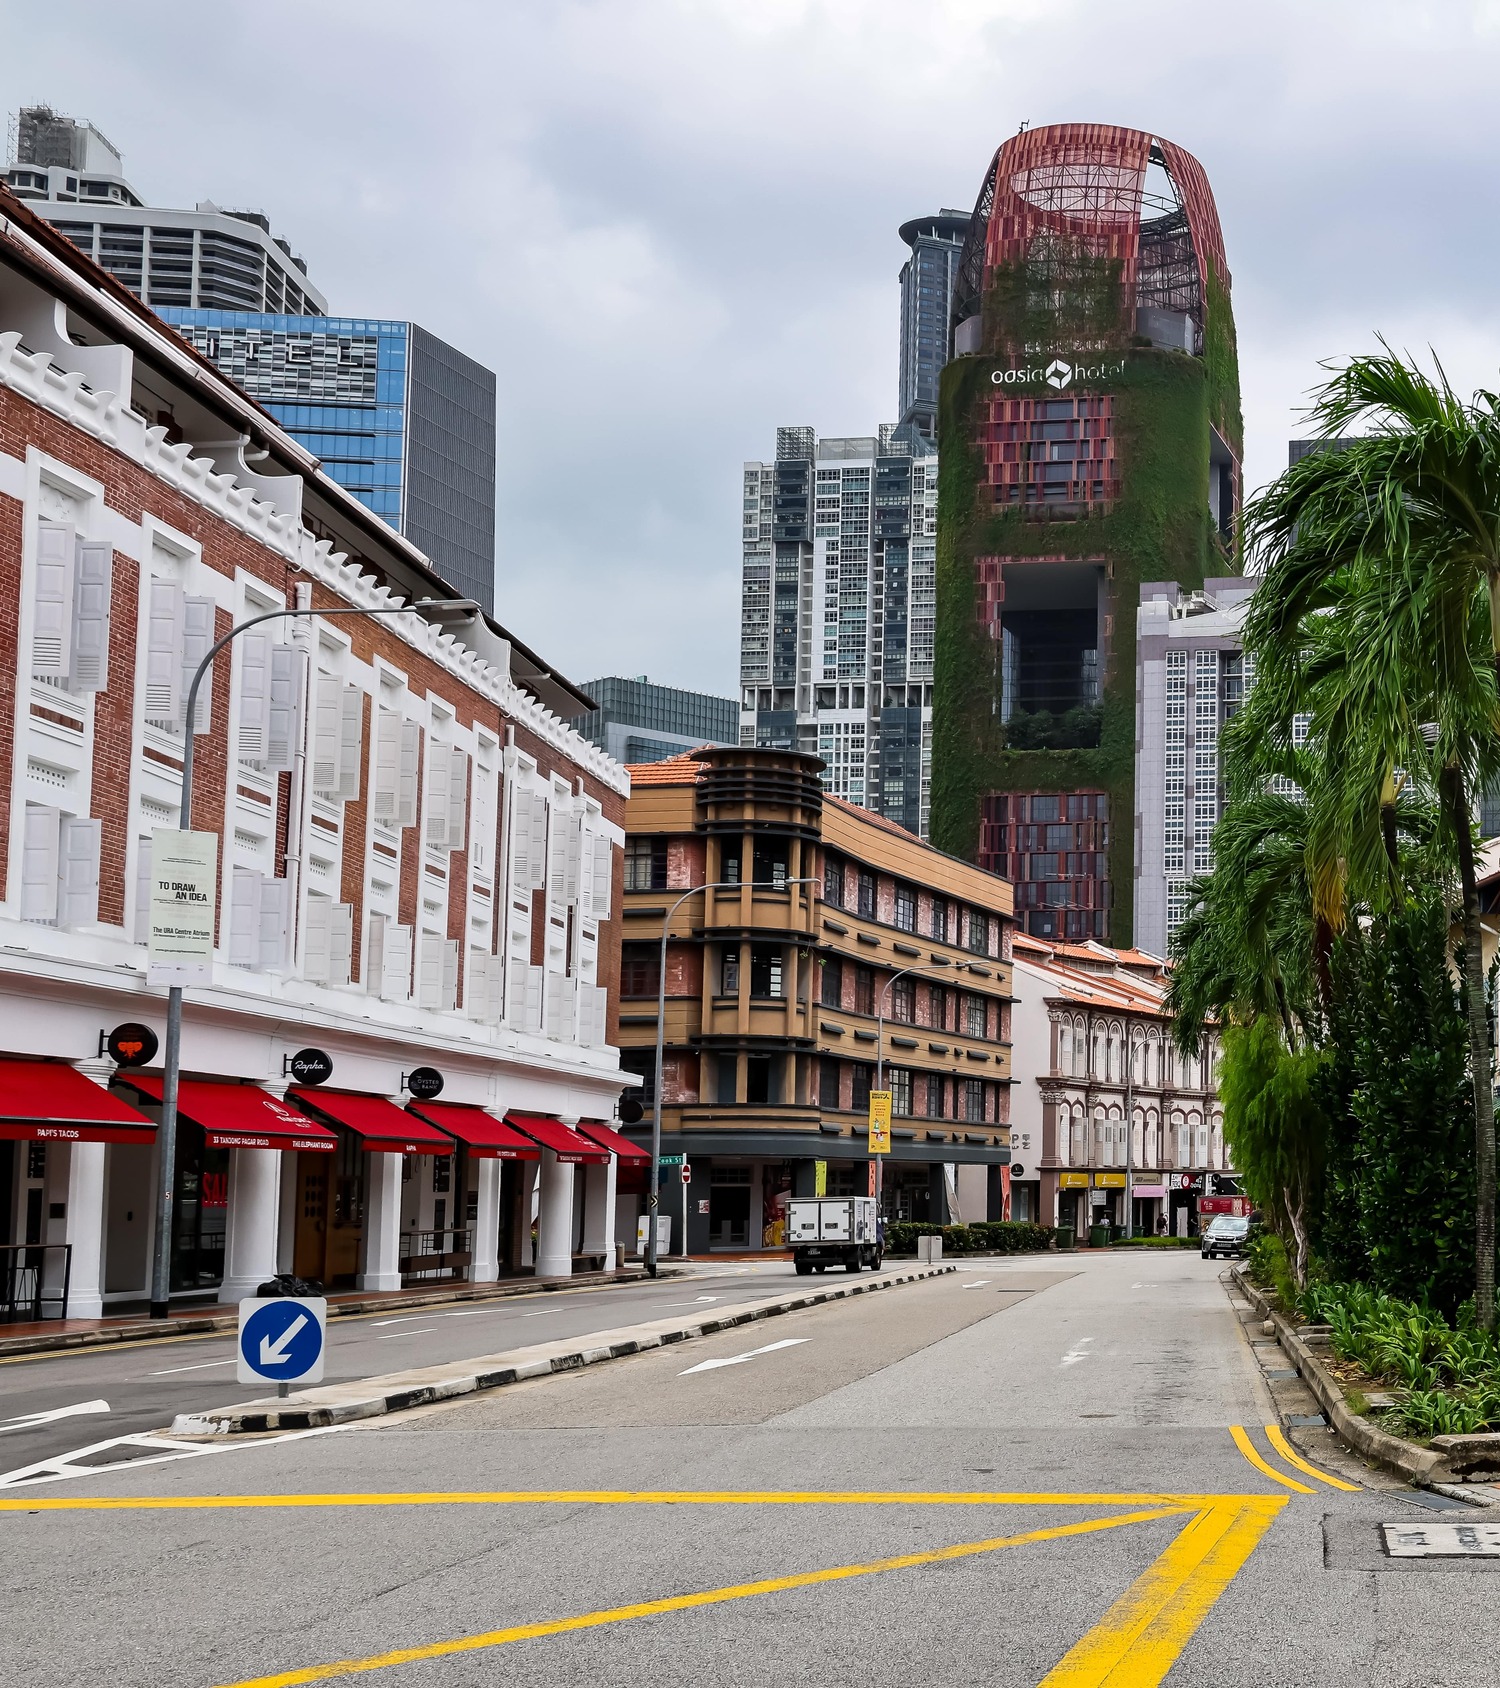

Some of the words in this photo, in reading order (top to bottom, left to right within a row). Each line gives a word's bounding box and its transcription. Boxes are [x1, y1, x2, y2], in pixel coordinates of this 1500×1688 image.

[209, 337, 358, 366] ITEL
[991, 365, 1043, 384] oasia
[1075, 360, 1125, 380] hotel
[159, 881, 169, 890] TO
[171, 882, 196, 892] DRAW
[175, 891, 187, 901] AN
[189, 893, 207, 901] IDEA
[153, 926, 163, 934] The
[174, 928, 192, 936] Centre
[192, 929, 210, 937] Atrium
[37, 1128, 58, 1137] PAPI'S
[58, 1129, 79, 1138] TACOS
[219, 1136, 242, 1145] TANJONG
[257, 1138, 269, 1146] ROAD
[301, 1141, 321, 1149] ELEPHANT
[202, 1170, 228, 1203] SAL
[165, 1191, 170, 1199] 5
